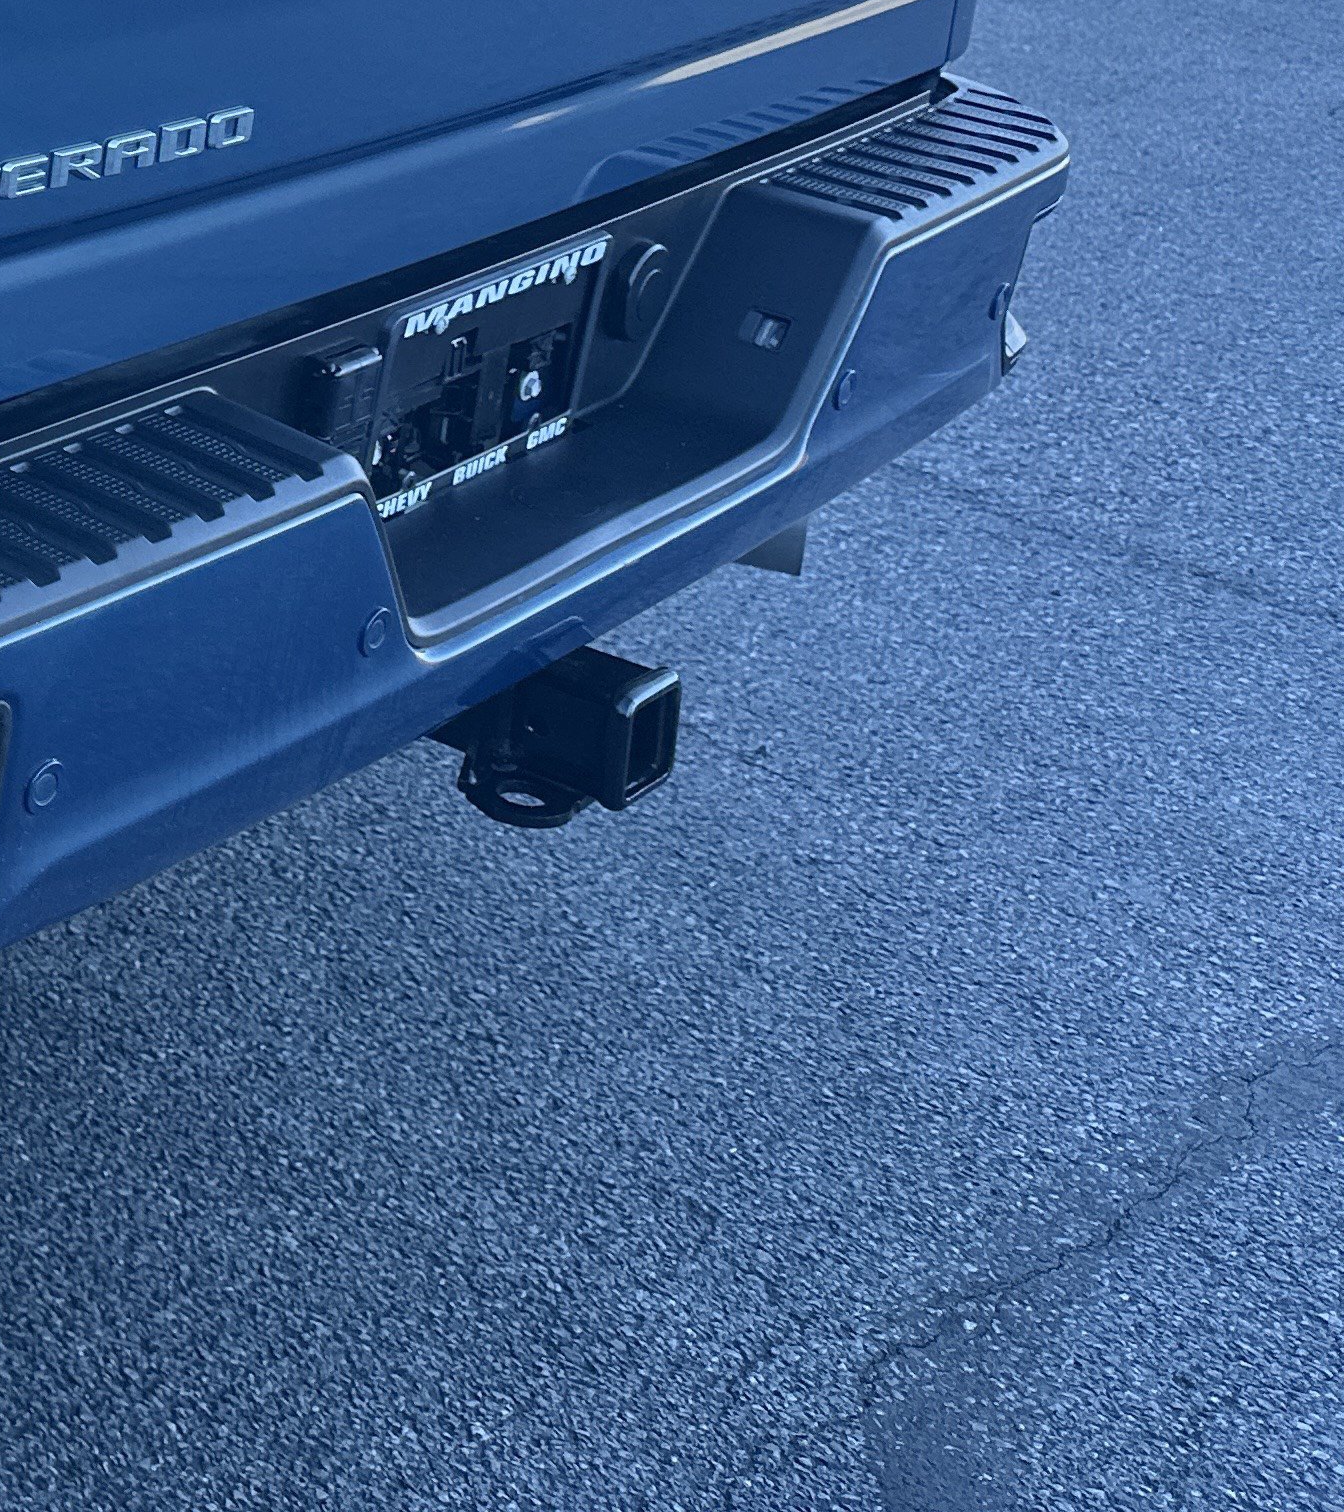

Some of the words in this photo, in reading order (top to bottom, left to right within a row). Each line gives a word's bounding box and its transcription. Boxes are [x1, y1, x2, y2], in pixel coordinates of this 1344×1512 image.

[404, 241, 607, 338] MANGINO
[451, 444, 509, 485] BUICK
[525, 416, 568, 450] GMC
